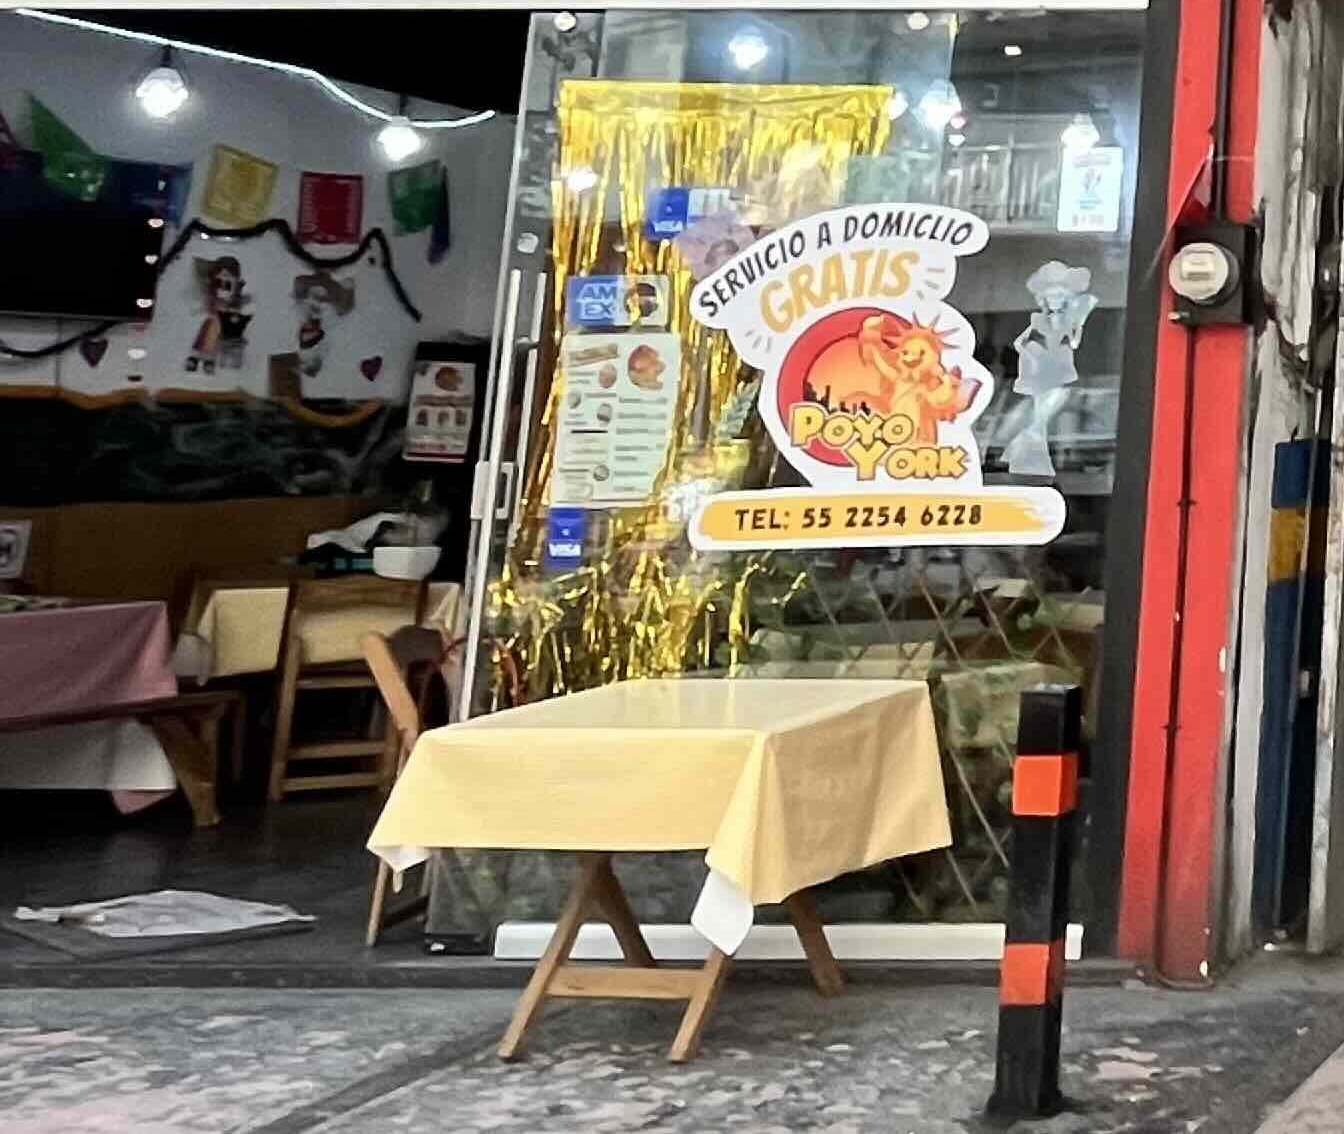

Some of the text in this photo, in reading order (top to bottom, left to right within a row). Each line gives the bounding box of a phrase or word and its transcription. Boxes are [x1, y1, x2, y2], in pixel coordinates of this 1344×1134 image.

[700, 231, 805, 317] SERVICIO
[817, 221, 832, 249] A
[760, 248, 921, 334] GRATIS
[790, 403, 914, 447] POYO
[845, 442, 968, 481] YORK
[735, 504, 982, 531] TEL: 55 2254 6228
